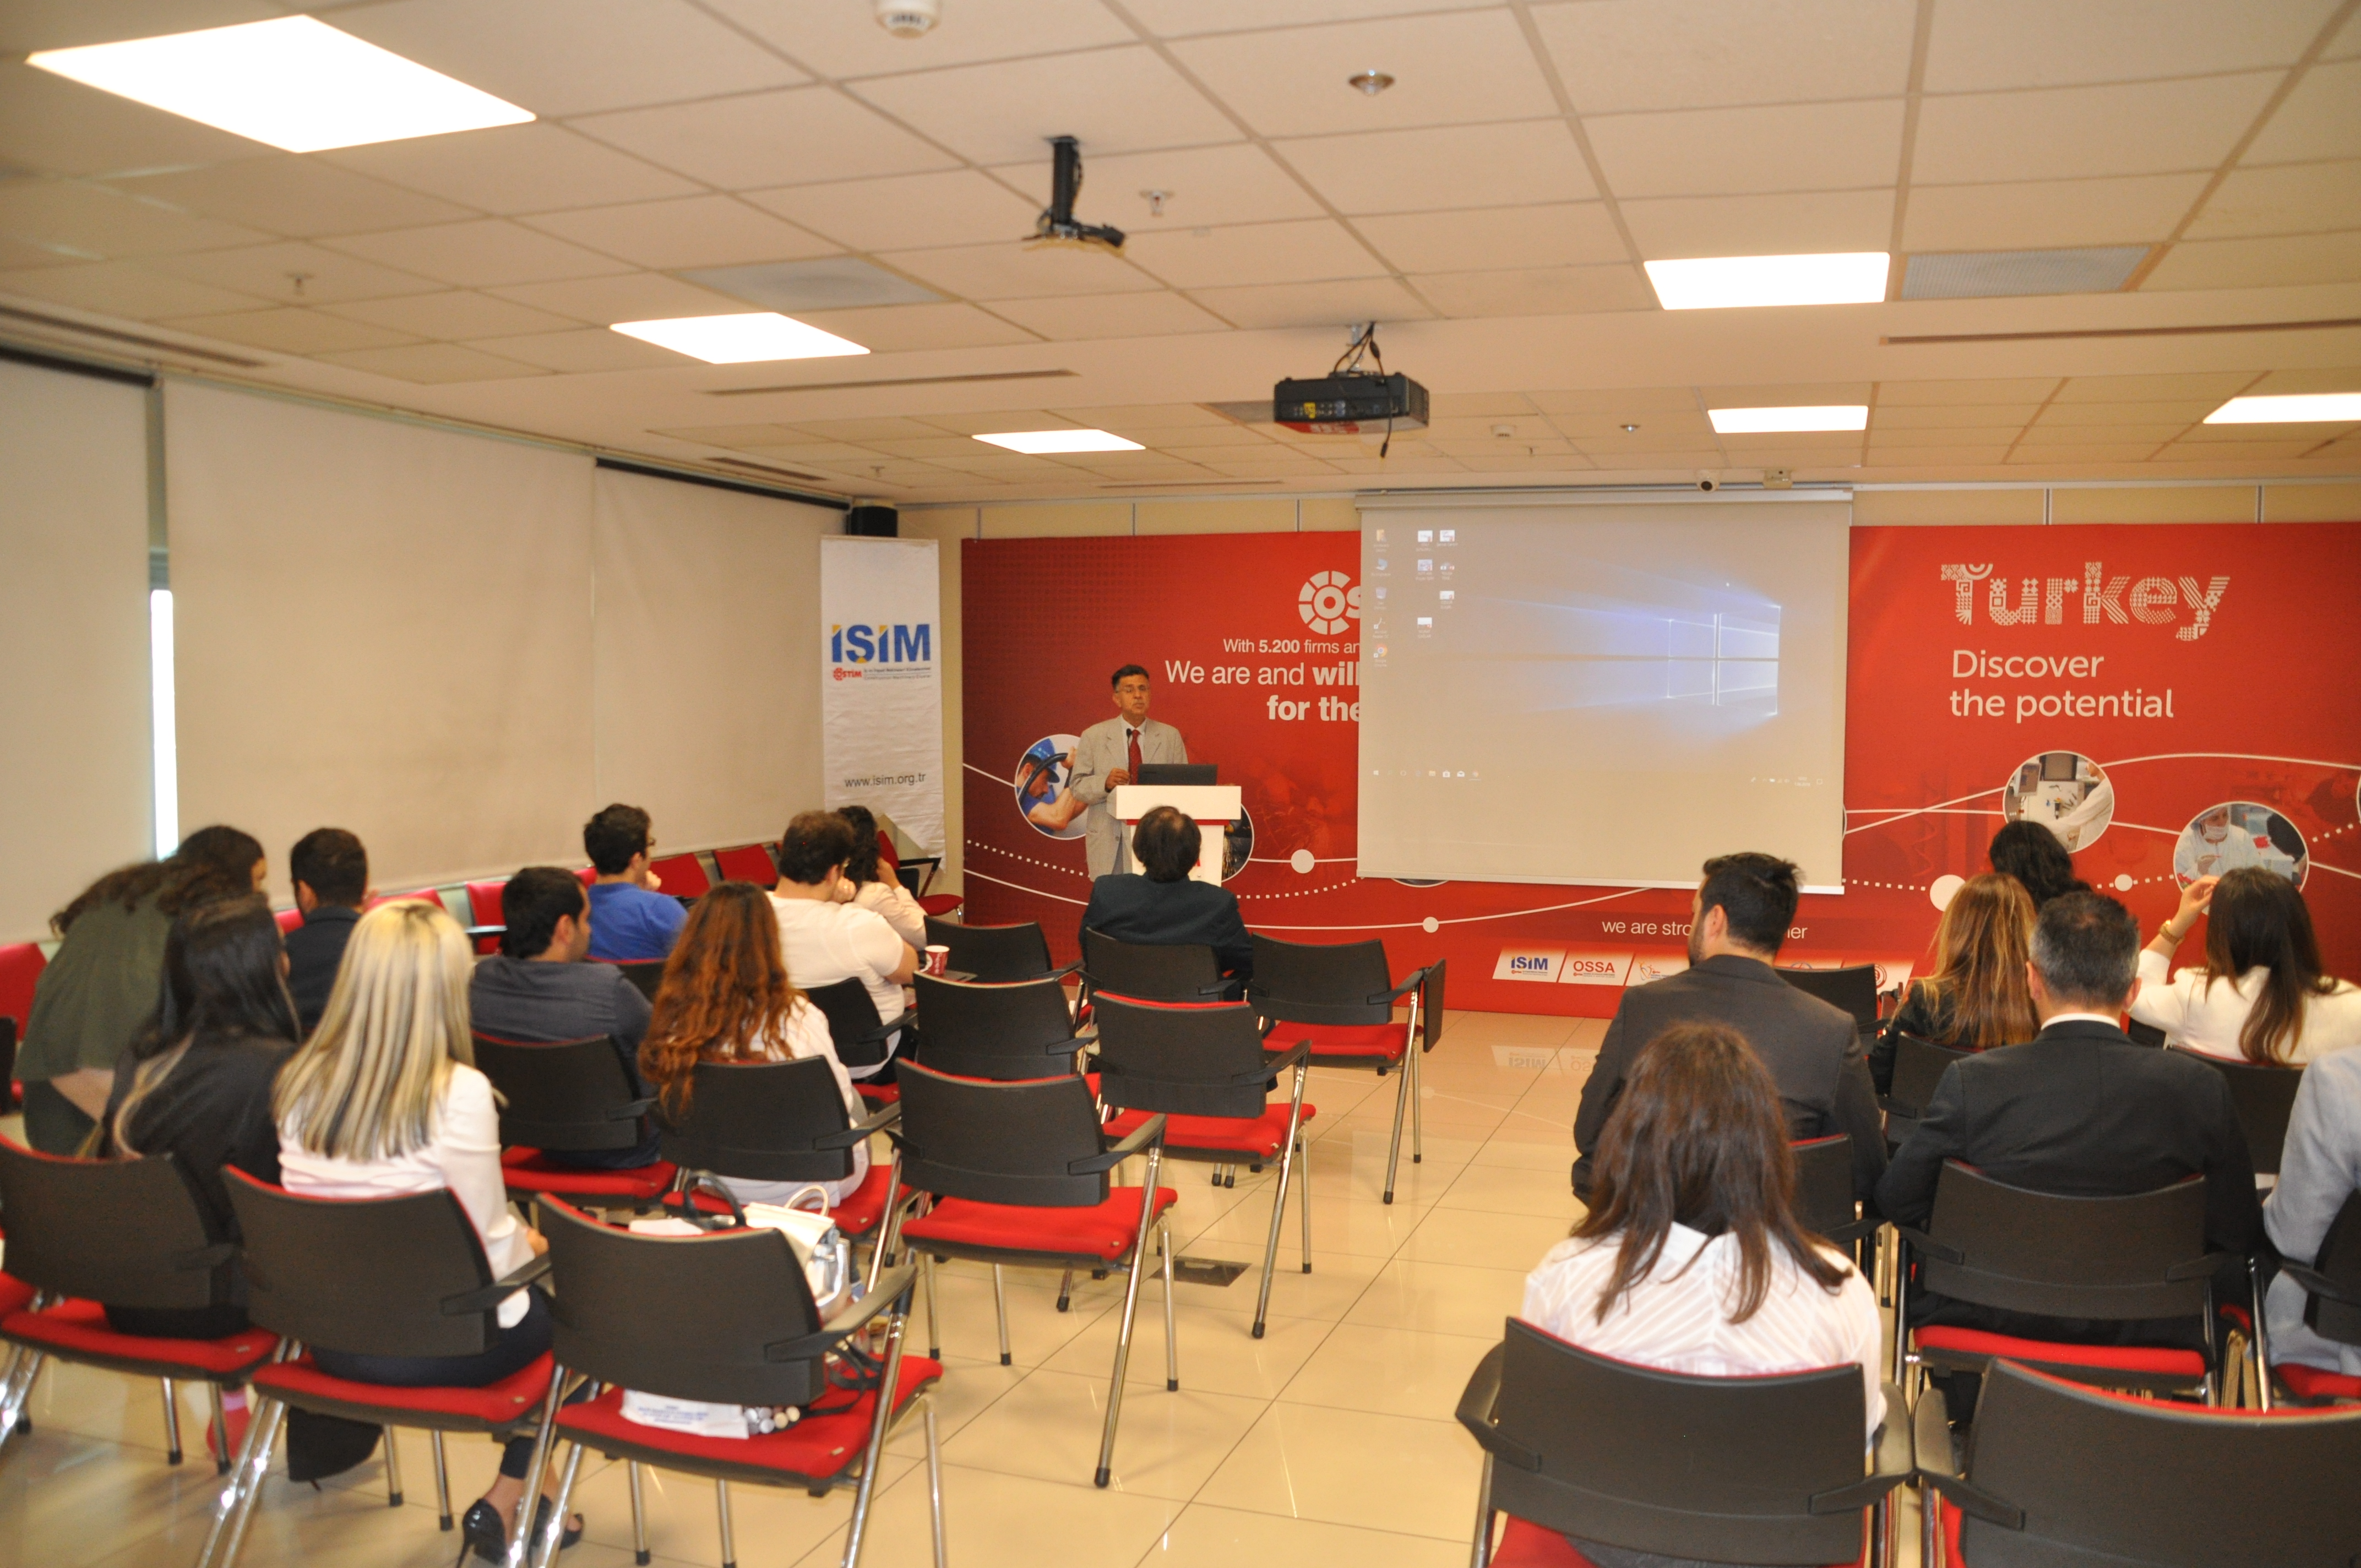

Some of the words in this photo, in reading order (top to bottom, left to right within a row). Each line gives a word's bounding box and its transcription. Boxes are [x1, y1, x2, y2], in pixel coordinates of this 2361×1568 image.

[1940, 562, 2231, 641] Turkey
[1223, 639, 1254, 653] With
[1259, 640, 1300, 654] 5.200
[1304, 640, 1339, 654] firms
[1165, 660, 1205, 683] We
[1212, 666, 1250, 684] are
[1258, 662, 1304, 685] and
[1952, 650, 2104, 678] Discover
[1266, 695, 1310, 720] for
[1950, 689, 2005, 716] the
[2016, 688, 2174, 723] potential
[845, 772, 926, 787] www.isim.org.tr
[1602, 922, 1625, 933] we
[1631, 922, 1657, 934] are
[1574, 961, 1615, 973] OSSA
